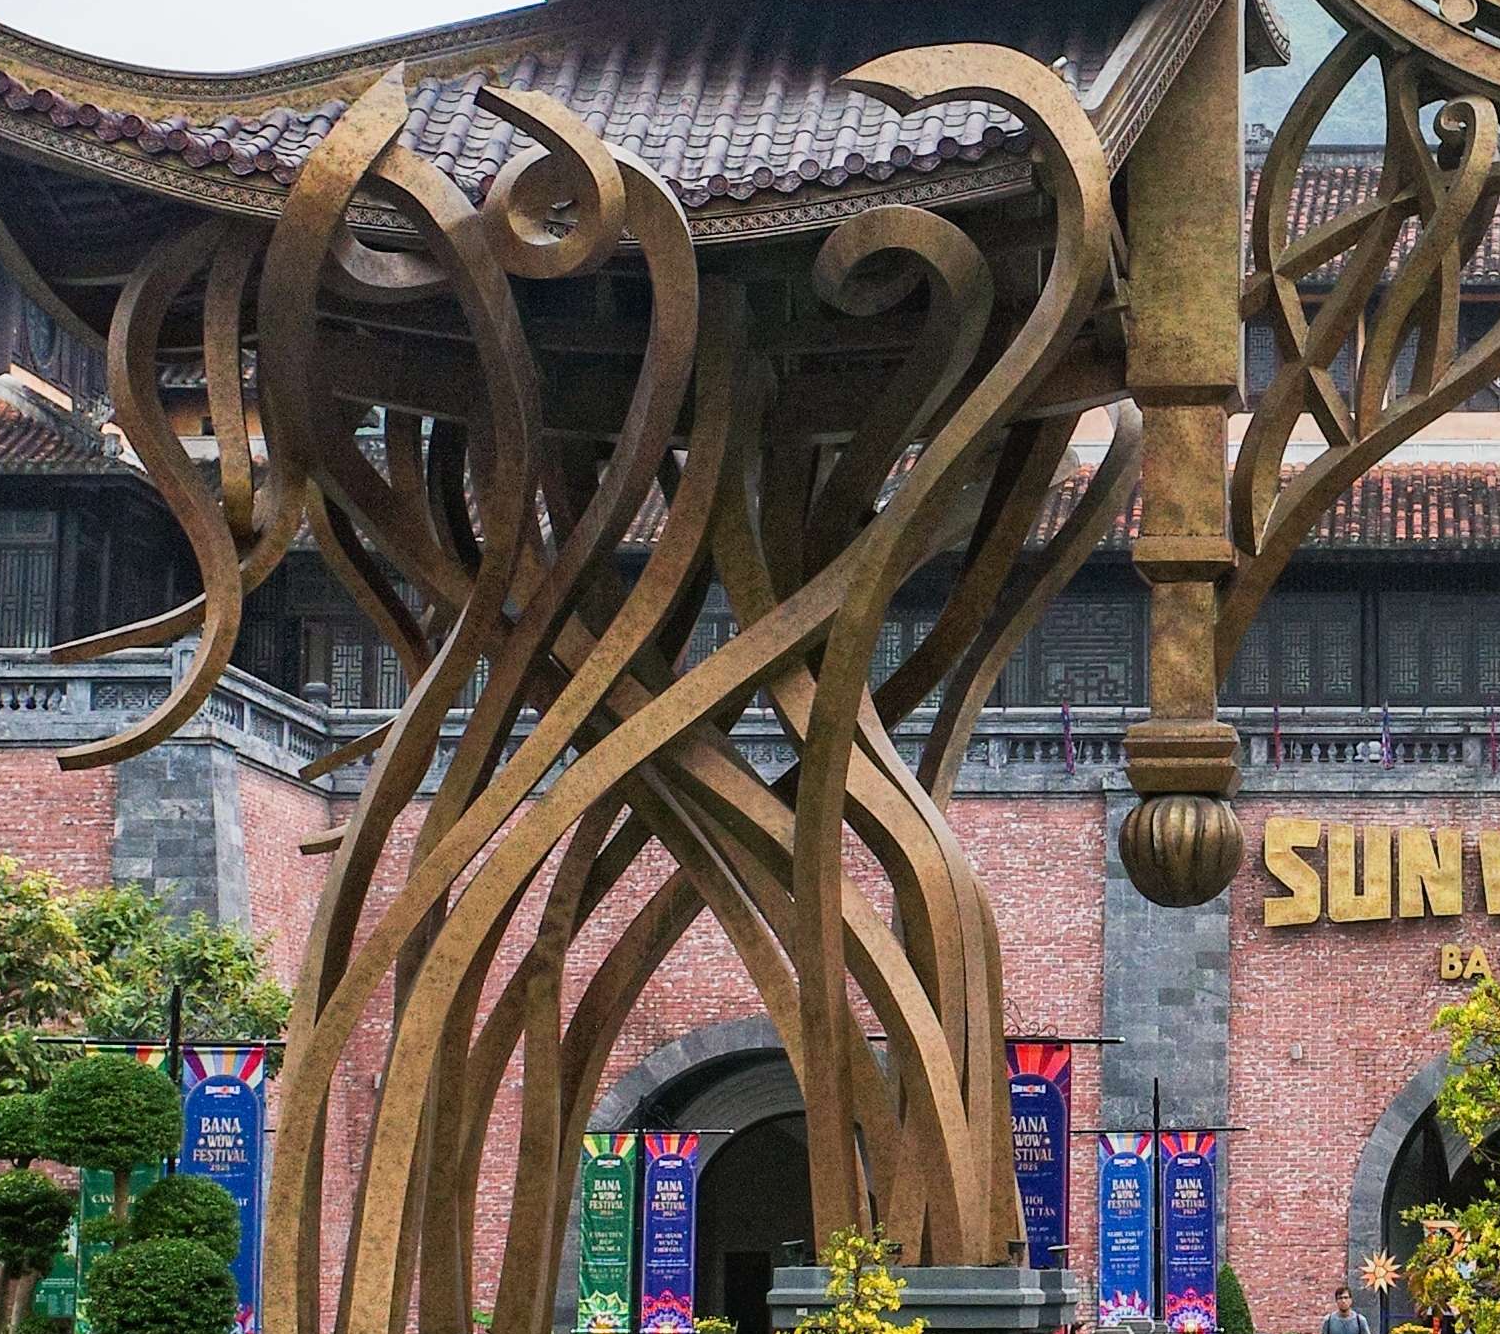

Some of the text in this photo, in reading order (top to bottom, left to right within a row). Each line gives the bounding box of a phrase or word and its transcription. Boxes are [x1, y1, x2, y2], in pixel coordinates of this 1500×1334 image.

[1263, 816, 1463, 928] SUN
[1441, 944, 1490, 981] BA
[201, 1117, 242, 1133] BANA
[207, 1135, 234, 1148] WOW
[1014, 1134, 1043, 1147] WOW
[193, 1149, 247, 1163] FESTIVAL
[1014, 1149, 1055, 1161] STIVAL
[594, 1180, 620, 1190] BANA
[656, 1180, 683, 1191] BANA
[1112, 1179, 1139, 1190] BANA
[1175, 1179, 1203, 1190] BANA
[598, 1192, 617, 1200] WOW
[660, 1192, 679, 1201] WOW
[1115, 1191, 1135, 1199] WOW
[1180, 1190, 1199, 1199] WOW
[589, 1200, 623, 1209] FESTIVAL
[651, 1201, 687, 1211] FESTIVAL
[1108, 1200, 1141, 1208] FESTIVAL
[1171, 1200, 1207, 1209] FESTIVAL
